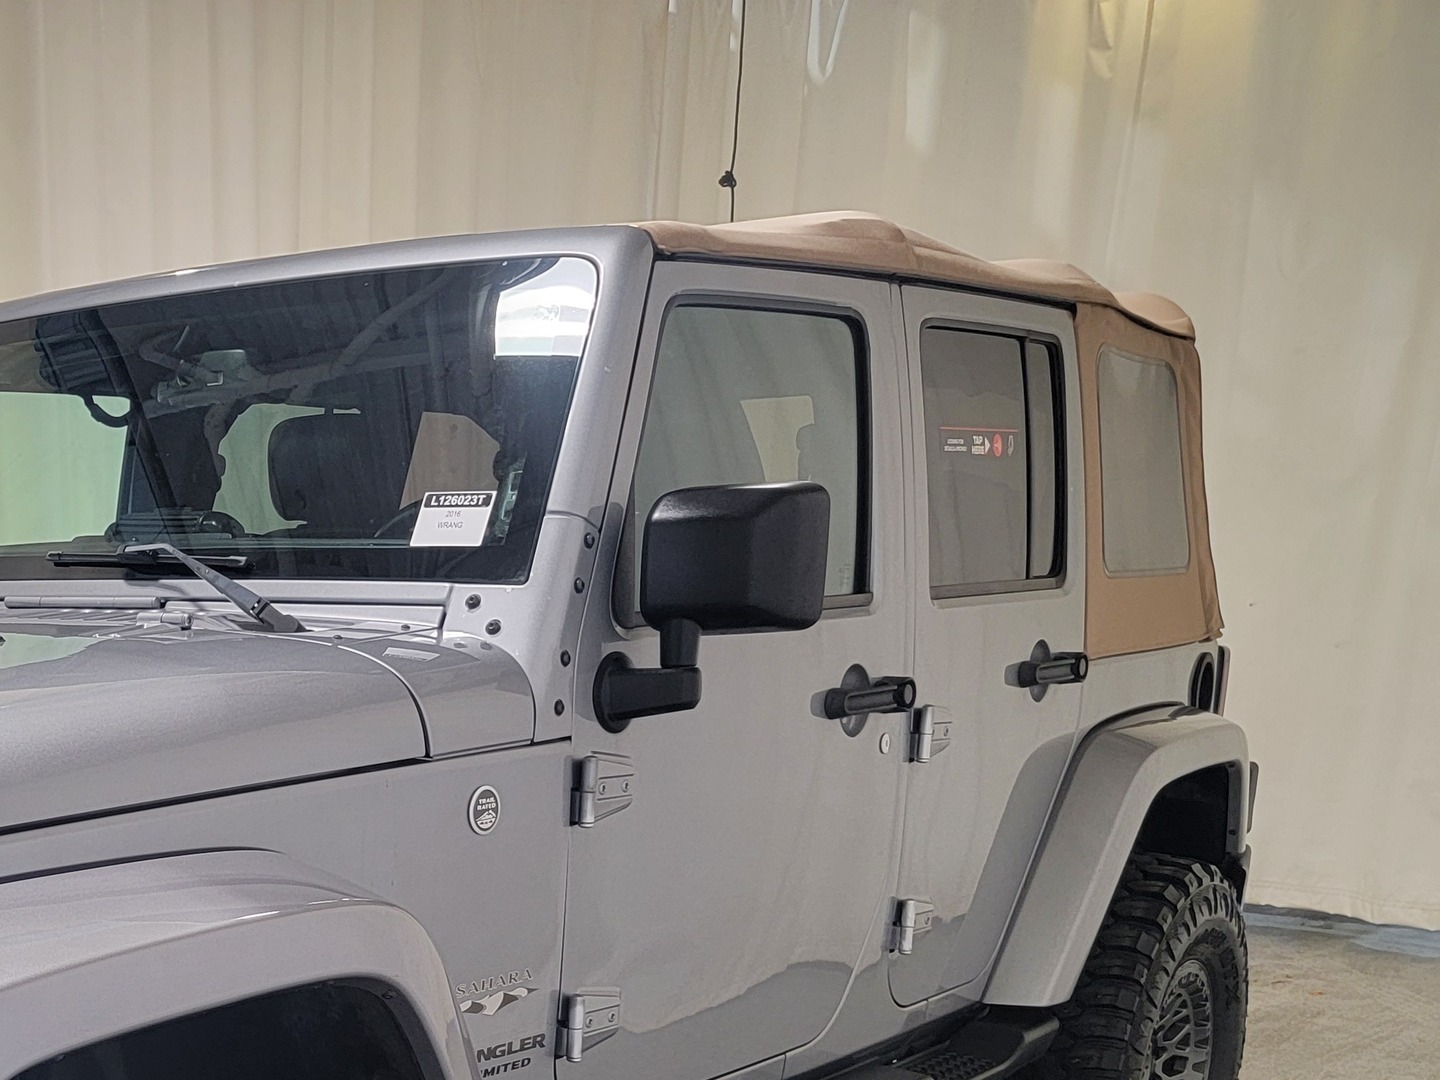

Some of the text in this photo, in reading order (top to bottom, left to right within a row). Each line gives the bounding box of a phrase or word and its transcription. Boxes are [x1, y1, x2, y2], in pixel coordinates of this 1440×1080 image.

[430, 495, 487, 506] L126023T
[445, 510, 462, 518] 2016
[437, 521, 464, 529] WRANG
[478, 796, 495, 804] TRAIL
[476, 803, 496, 811] RATED
[456, 968, 534, 999] SAHARA
[476, 1033, 546, 1063] NGLER
[481, 1057, 531, 1078] MITED
